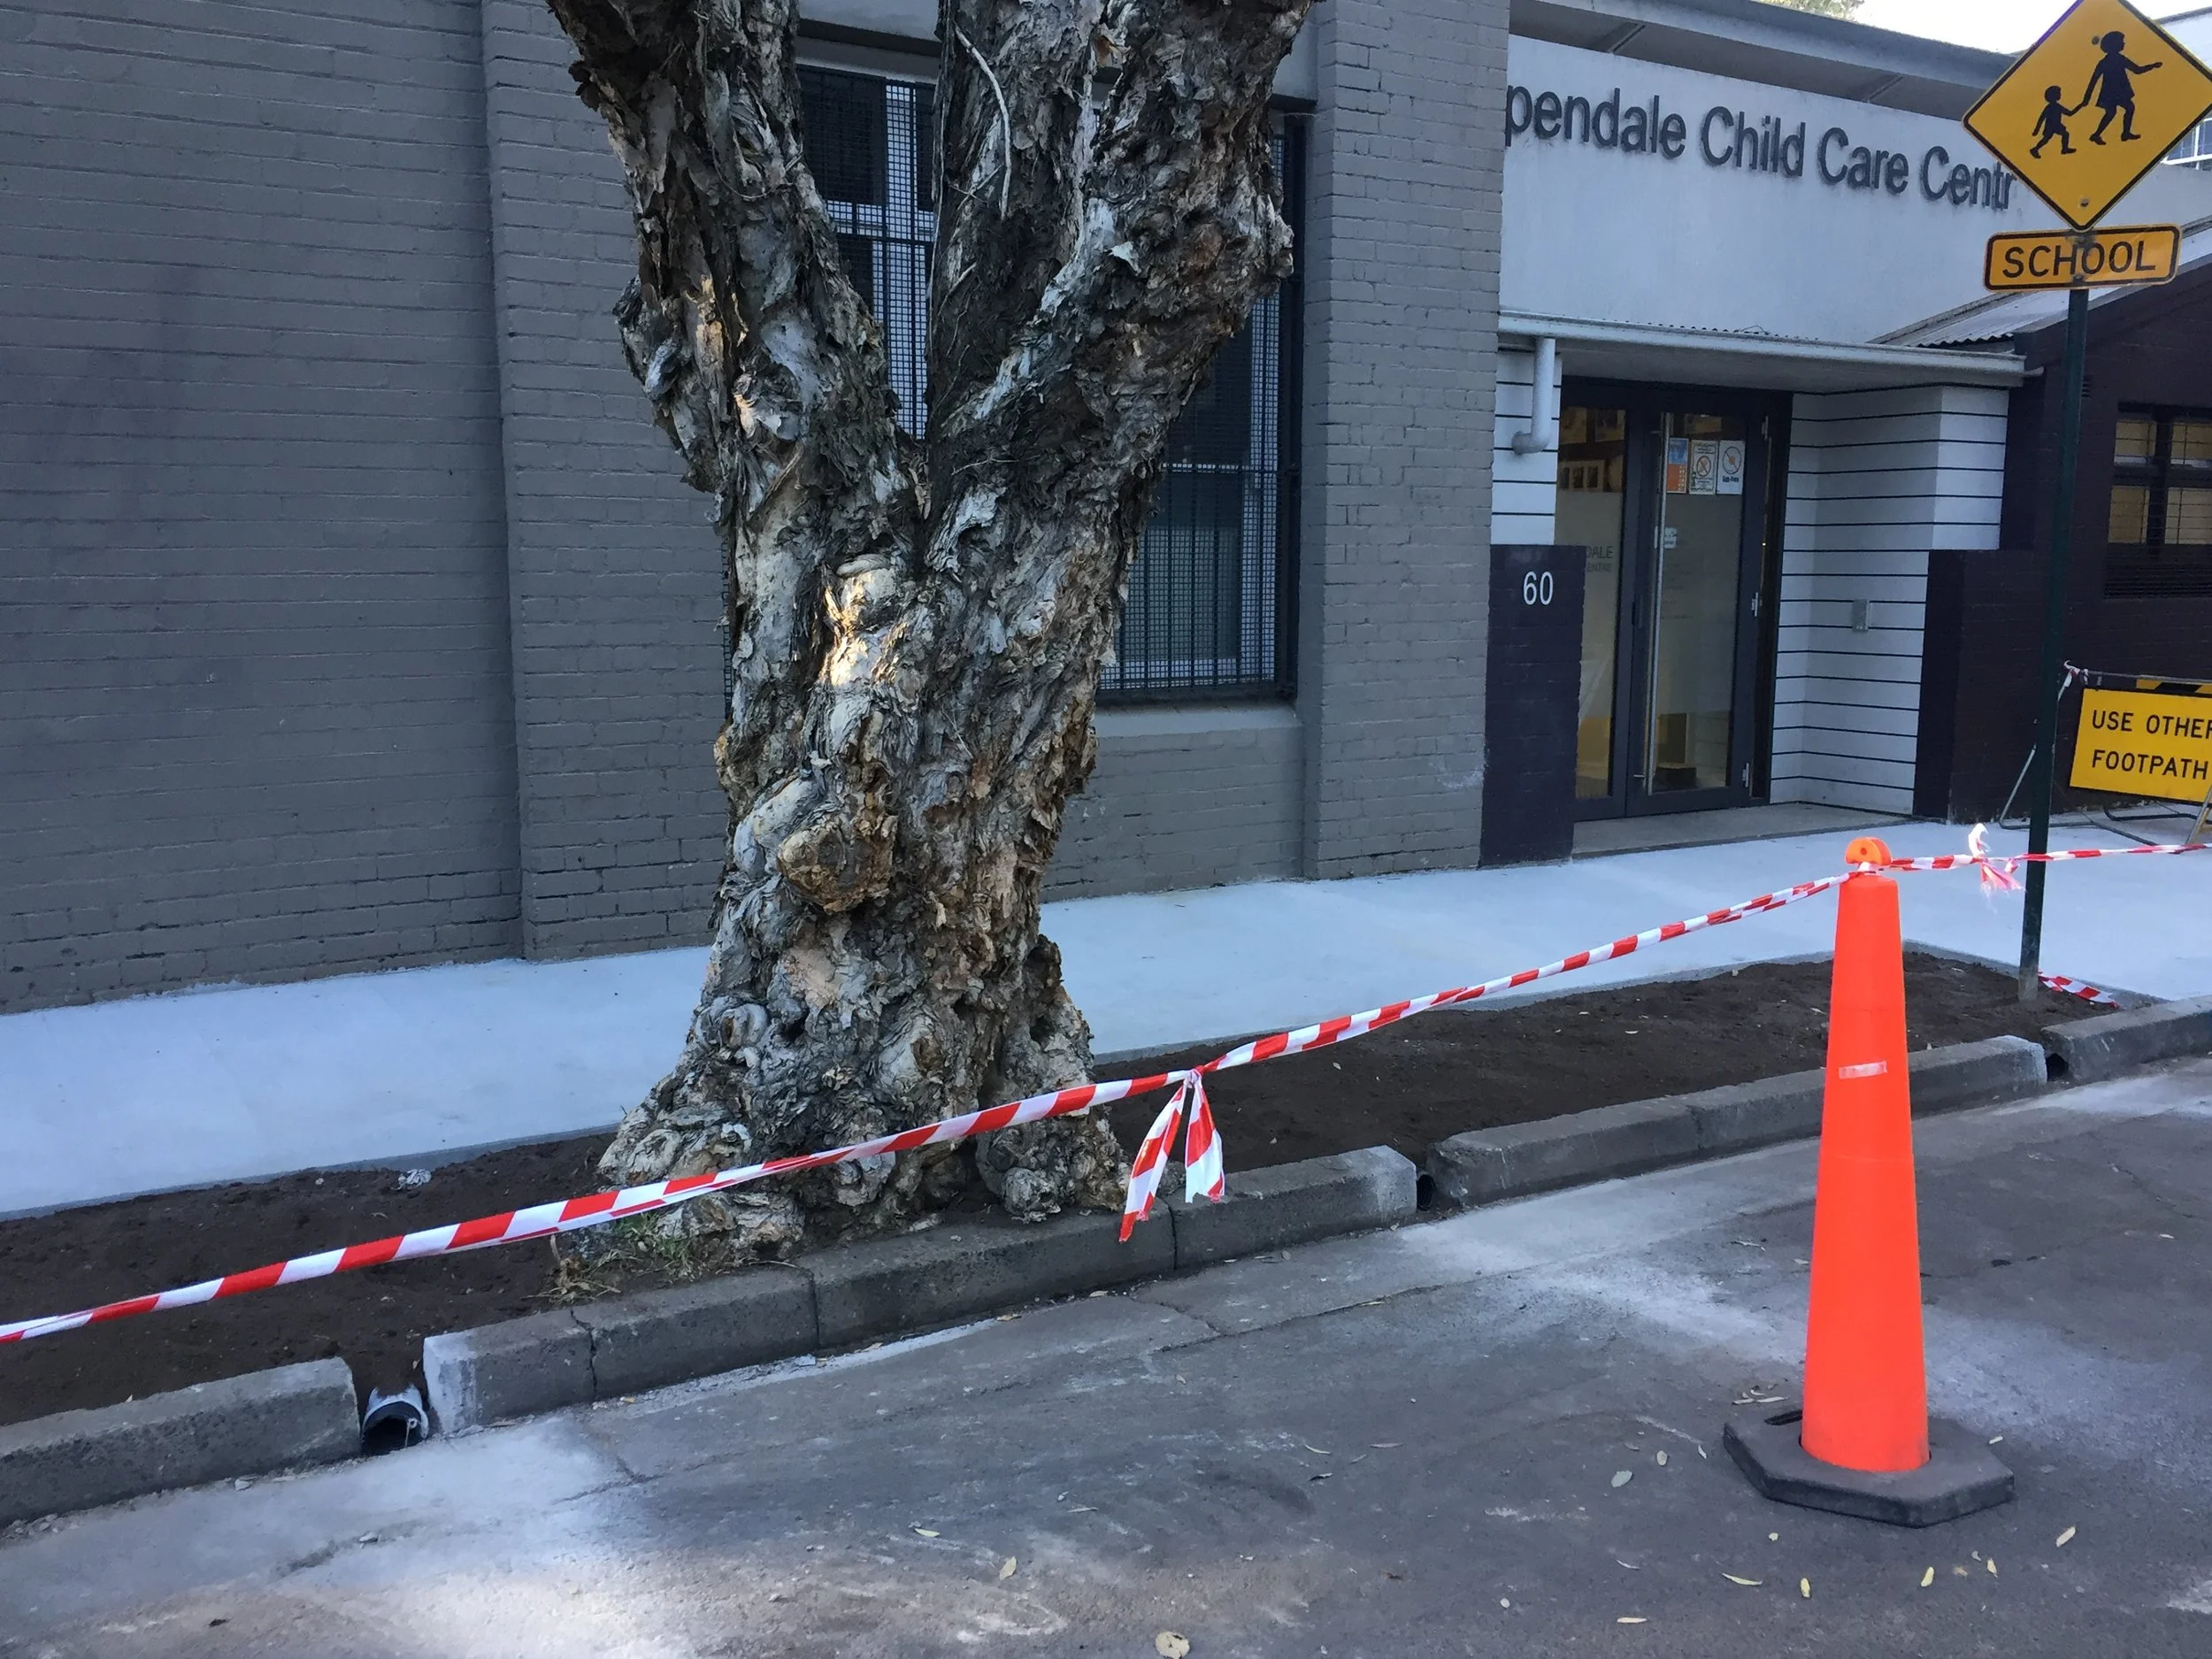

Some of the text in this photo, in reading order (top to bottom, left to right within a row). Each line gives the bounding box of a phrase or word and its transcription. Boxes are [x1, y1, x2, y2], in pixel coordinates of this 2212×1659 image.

[1701, 105, 1806, 177] Child
[1818, 127, 1909, 195] Care
[2002, 240, 2156, 279] SCHOOL
[1523, 571, 1554, 605] 60
[2092, 709, 2134, 732] USE
[2092, 749, 2209, 780] FOOTPATH
